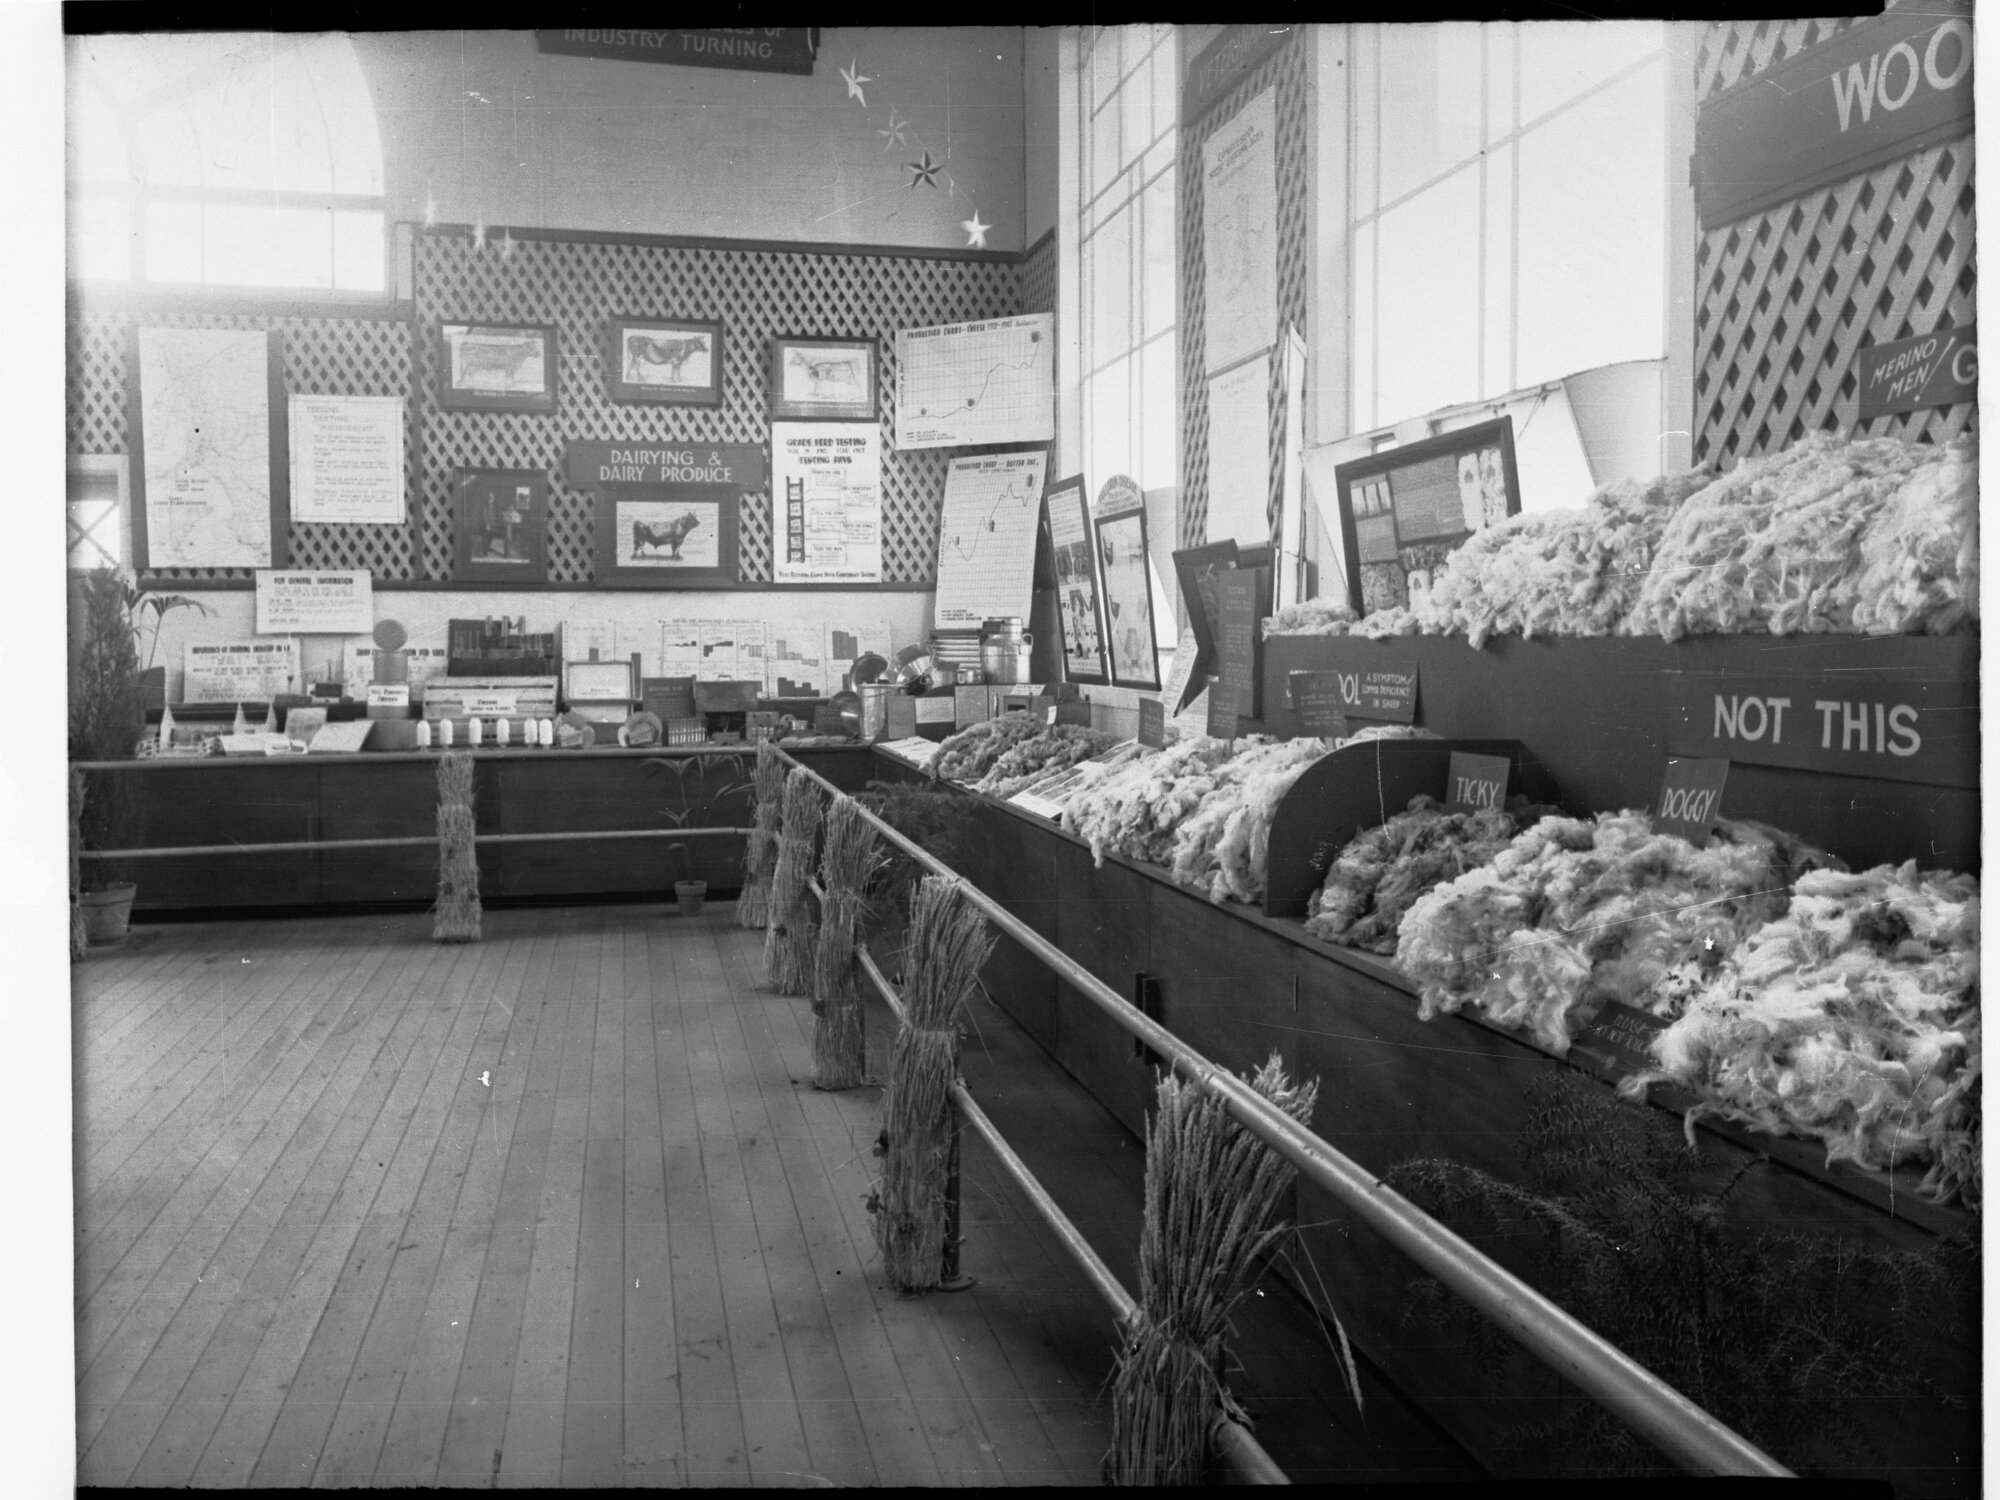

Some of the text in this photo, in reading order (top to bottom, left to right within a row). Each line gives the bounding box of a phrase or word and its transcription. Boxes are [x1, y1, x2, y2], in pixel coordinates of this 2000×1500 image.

[564, 29, 773, 58] INDUSTRY TURNING
[1869, 338, 1938, 390] MERINO
[835, 437, 866, 447] TESTING
[611, 449, 722, 466] DAIRYING &
[799, 456, 830, 465] TESTING
[600, 465, 732, 483] DAIRY PRODUCE
[274, 577, 354, 585] FOR GENERAL INFORMATION
[1366, 673, 1371, 682] A
[1373, 673, 1407, 685] SYMPTOM
[1380, 684, 1411, 697] DEFICIENCY
[1713, 694, 1922, 756] NOT THIS
[1456, 776, 1500, 808] TICKY
[1661, 787, 1716, 824] DOGGY
